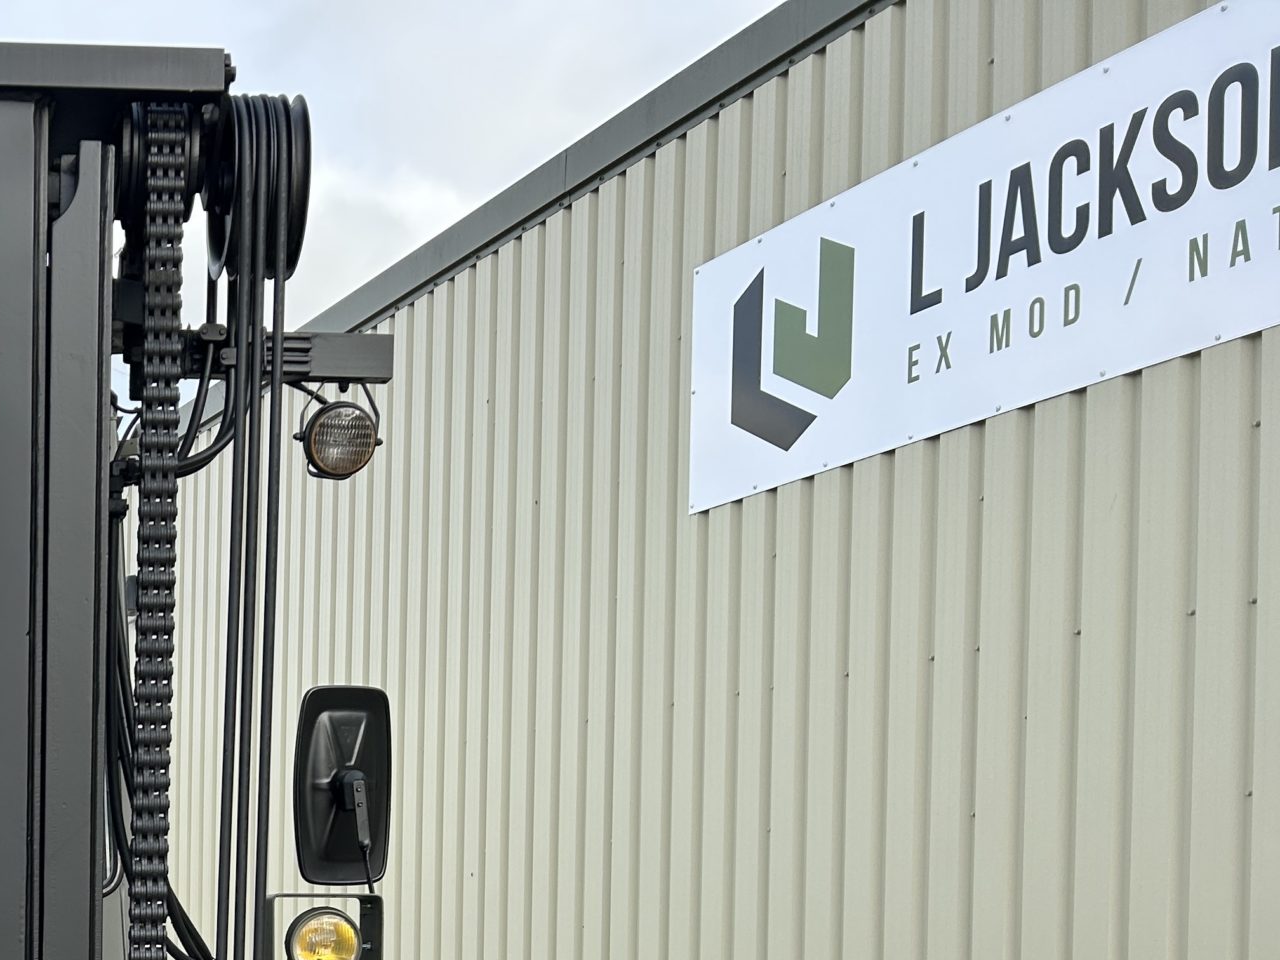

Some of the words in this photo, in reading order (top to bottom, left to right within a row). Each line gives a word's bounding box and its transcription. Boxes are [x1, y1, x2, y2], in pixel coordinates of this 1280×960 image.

[909, 210, 943, 315] L
[907, 331, 953, 384] EX
[989, 283, 1081, 354] MOD
[1123, 258, 1143, 306] /
